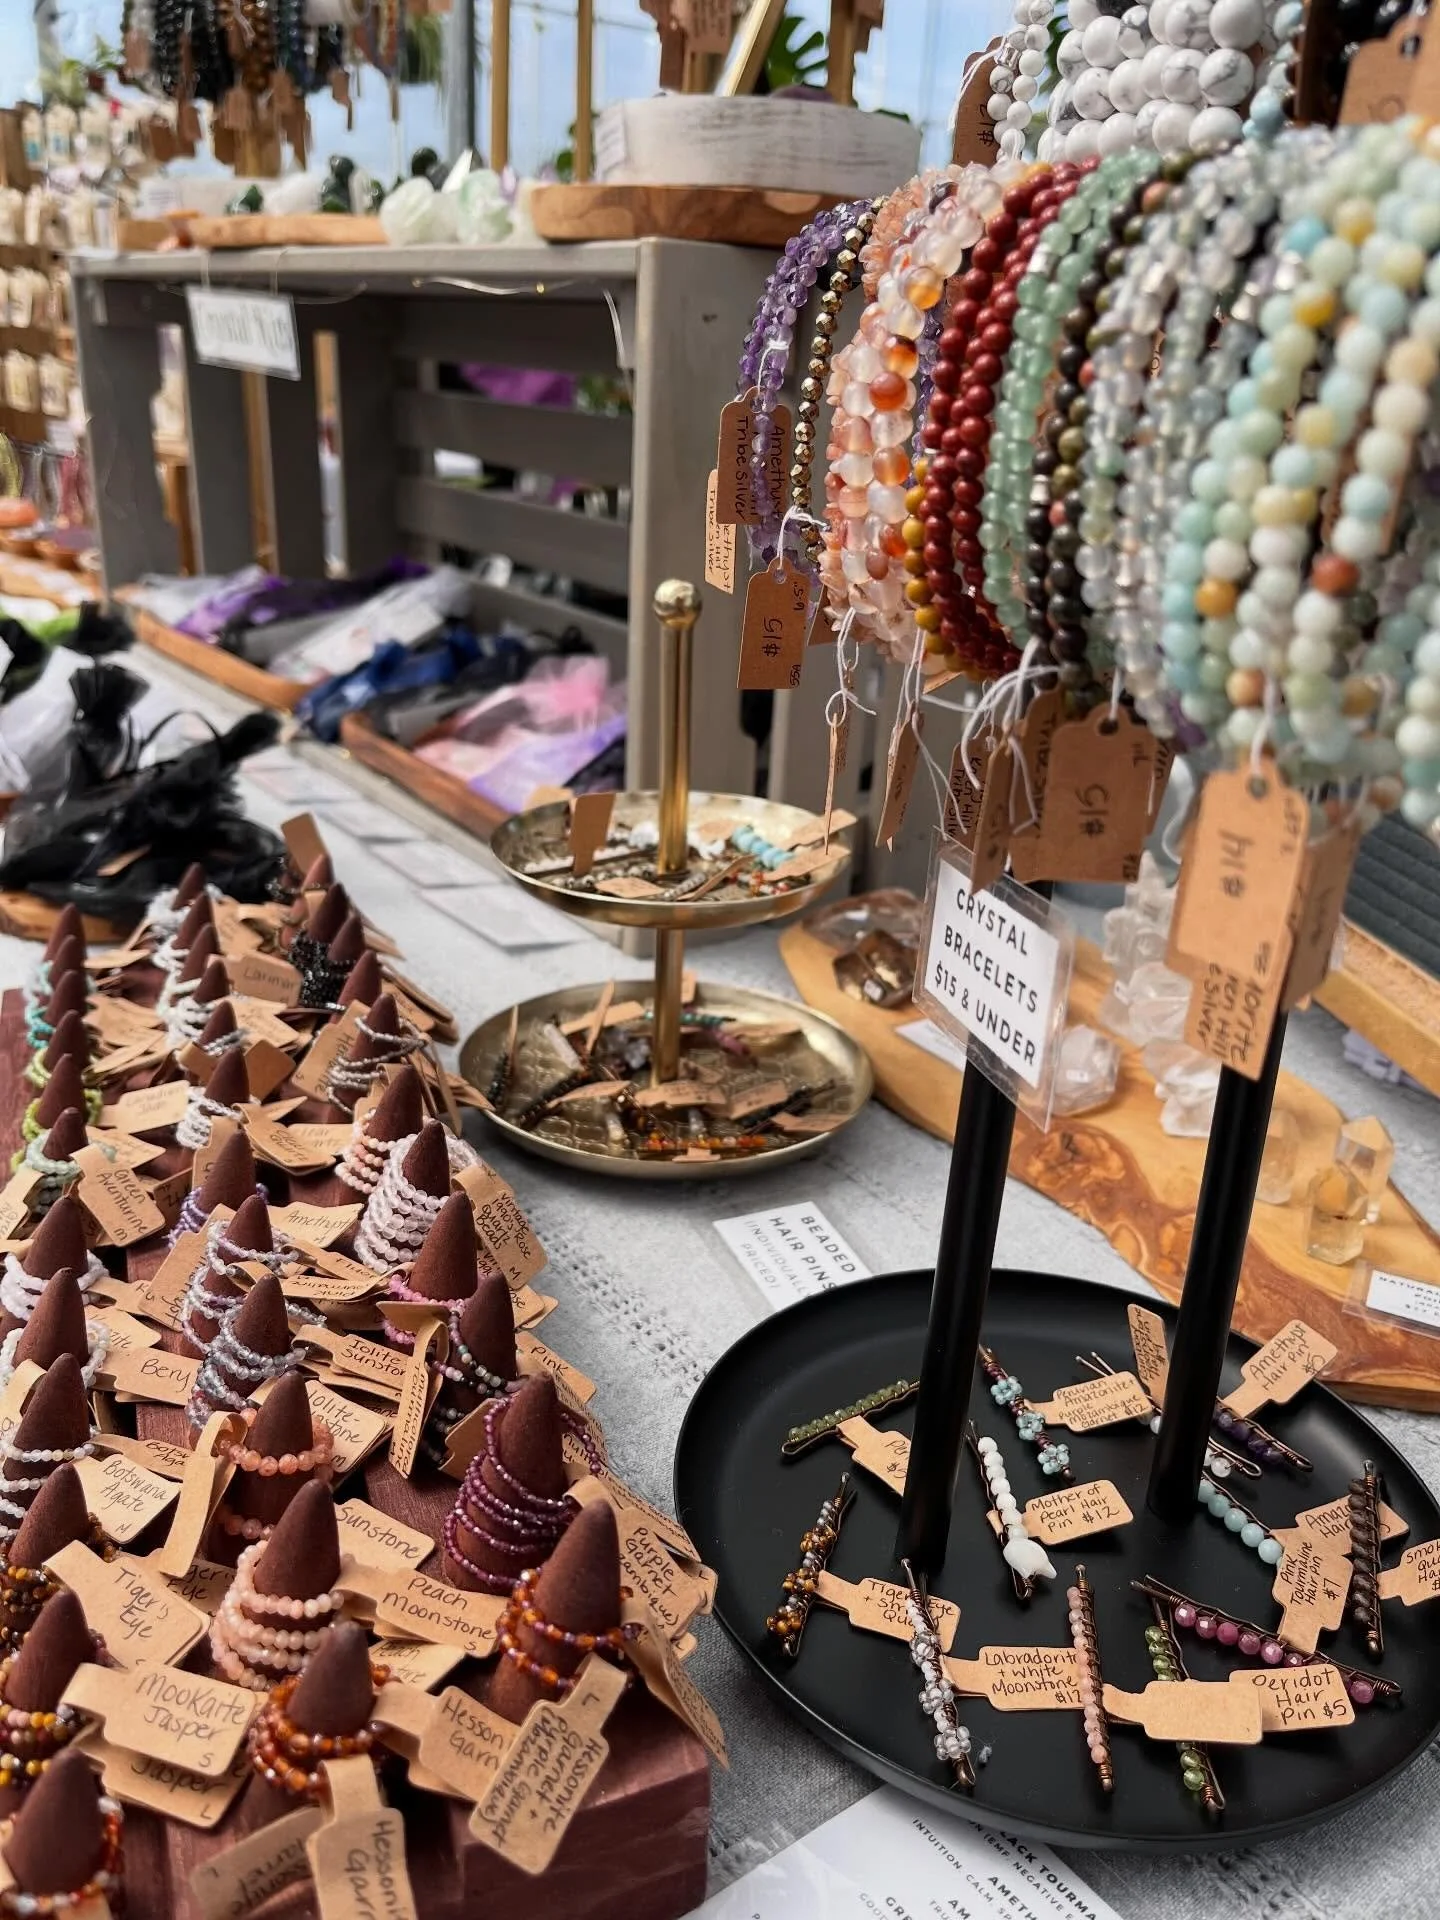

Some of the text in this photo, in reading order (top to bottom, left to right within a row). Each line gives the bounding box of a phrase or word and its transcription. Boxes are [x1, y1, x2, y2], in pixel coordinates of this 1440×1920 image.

[735, 416, 749, 521] Tribe Silver
[763, 617, 783, 658] $15
[956, 888, 1028, 955] CRYSTAL
[944, 924, 1038, 1013] BRACELETS
[934, 961, 1036, 1065] $15 & UNDER
[113, 1168, 146, 1205] Green
[769, 1217, 837, 1290] HAIR PINS
[800, 1215, 856, 1273] BEADED
[140, 1358, 193, 1393] Bery
[530, 1345, 569, 1375] Pink
[1261, 1362, 1289, 1391] Hair
[102, 1458, 168, 1501] Botswana
[158, 1452, 185, 1468] Aga
[99, 1481, 146, 1512] Agate
[1031, 1483, 1101, 1511] Mother of
[1080, 1496, 1109, 1510] Hair
[1082, 1506, 1120, 1524] $12
[336, 1505, 421, 1559] Sunstone
[625, 1537, 677, 1596] Garnet
[633, 1527, 675, 1581] Purple
[1280, 1554, 1299, 1585] Pink
[1290, 1541, 1313, 1606] Tourmaline
[112, 1566, 170, 1621] Tiger's
[618, 1552, 681, 1626] zambique)
[1304, 1576, 1318, 1606] Hair
[1322, 1578, 1341, 1601] $7
[118, 1605, 153, 1640] Eye
[382, 1592, 496, 1640] Moonstone
[992, 1676, 1078, 1697] Moonstone
[1276, 1688, 1325, 1708] Hair
[143, 1705, 228, 1742] Jasper
[442, 1695, 504, 1752] Hesson
[1323, 1699, 1347, 1720] $5
[199, 1752, 214, 1768] S
[449, 1730, 500, 1772] Garn
[539, 1732, 585, 1803] Garnet
[543, 1738, 604, 1834] Hessonite
[1000, 1831, 1038, 1864] LACK
[1013, 1861, 1064, 1912] NEGATIVE
